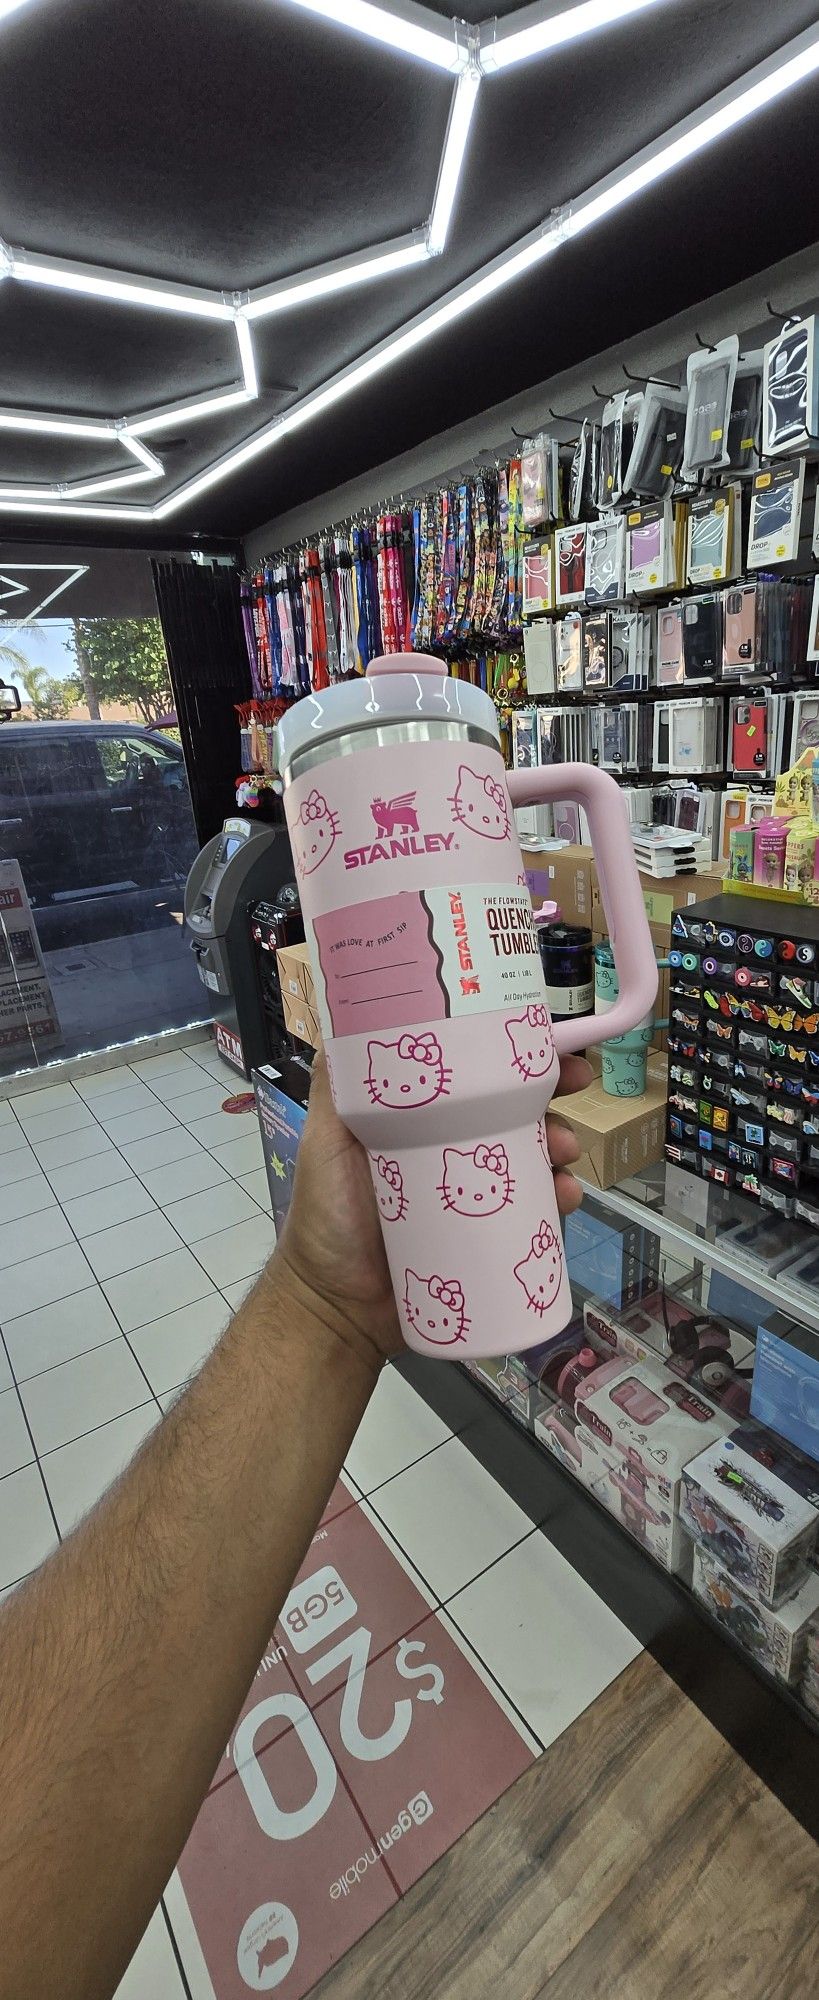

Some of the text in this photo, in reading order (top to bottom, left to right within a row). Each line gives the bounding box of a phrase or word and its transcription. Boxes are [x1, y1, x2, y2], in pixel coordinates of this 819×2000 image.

[343, 832, 455, 870] STANLEY
[483, 897, 497, 905] THE
[334, 939, 347, 950] WAS
[347, 938, 363, 948] LOVE
[365, 940, 375, 948] AT
[377, 931, 396, 947] FIRST
[396, 922, 408, 934] SIP
[448, 892, 473, 971] STANLEY
[501, 971, 508, 979] 40
[513, 992, 523, 1001] Day
[216, 1026, 243, 1060] ATM
[286, 1581, 345, 1633] 5GB
[329, 1810, 412, 1899] genmobile
